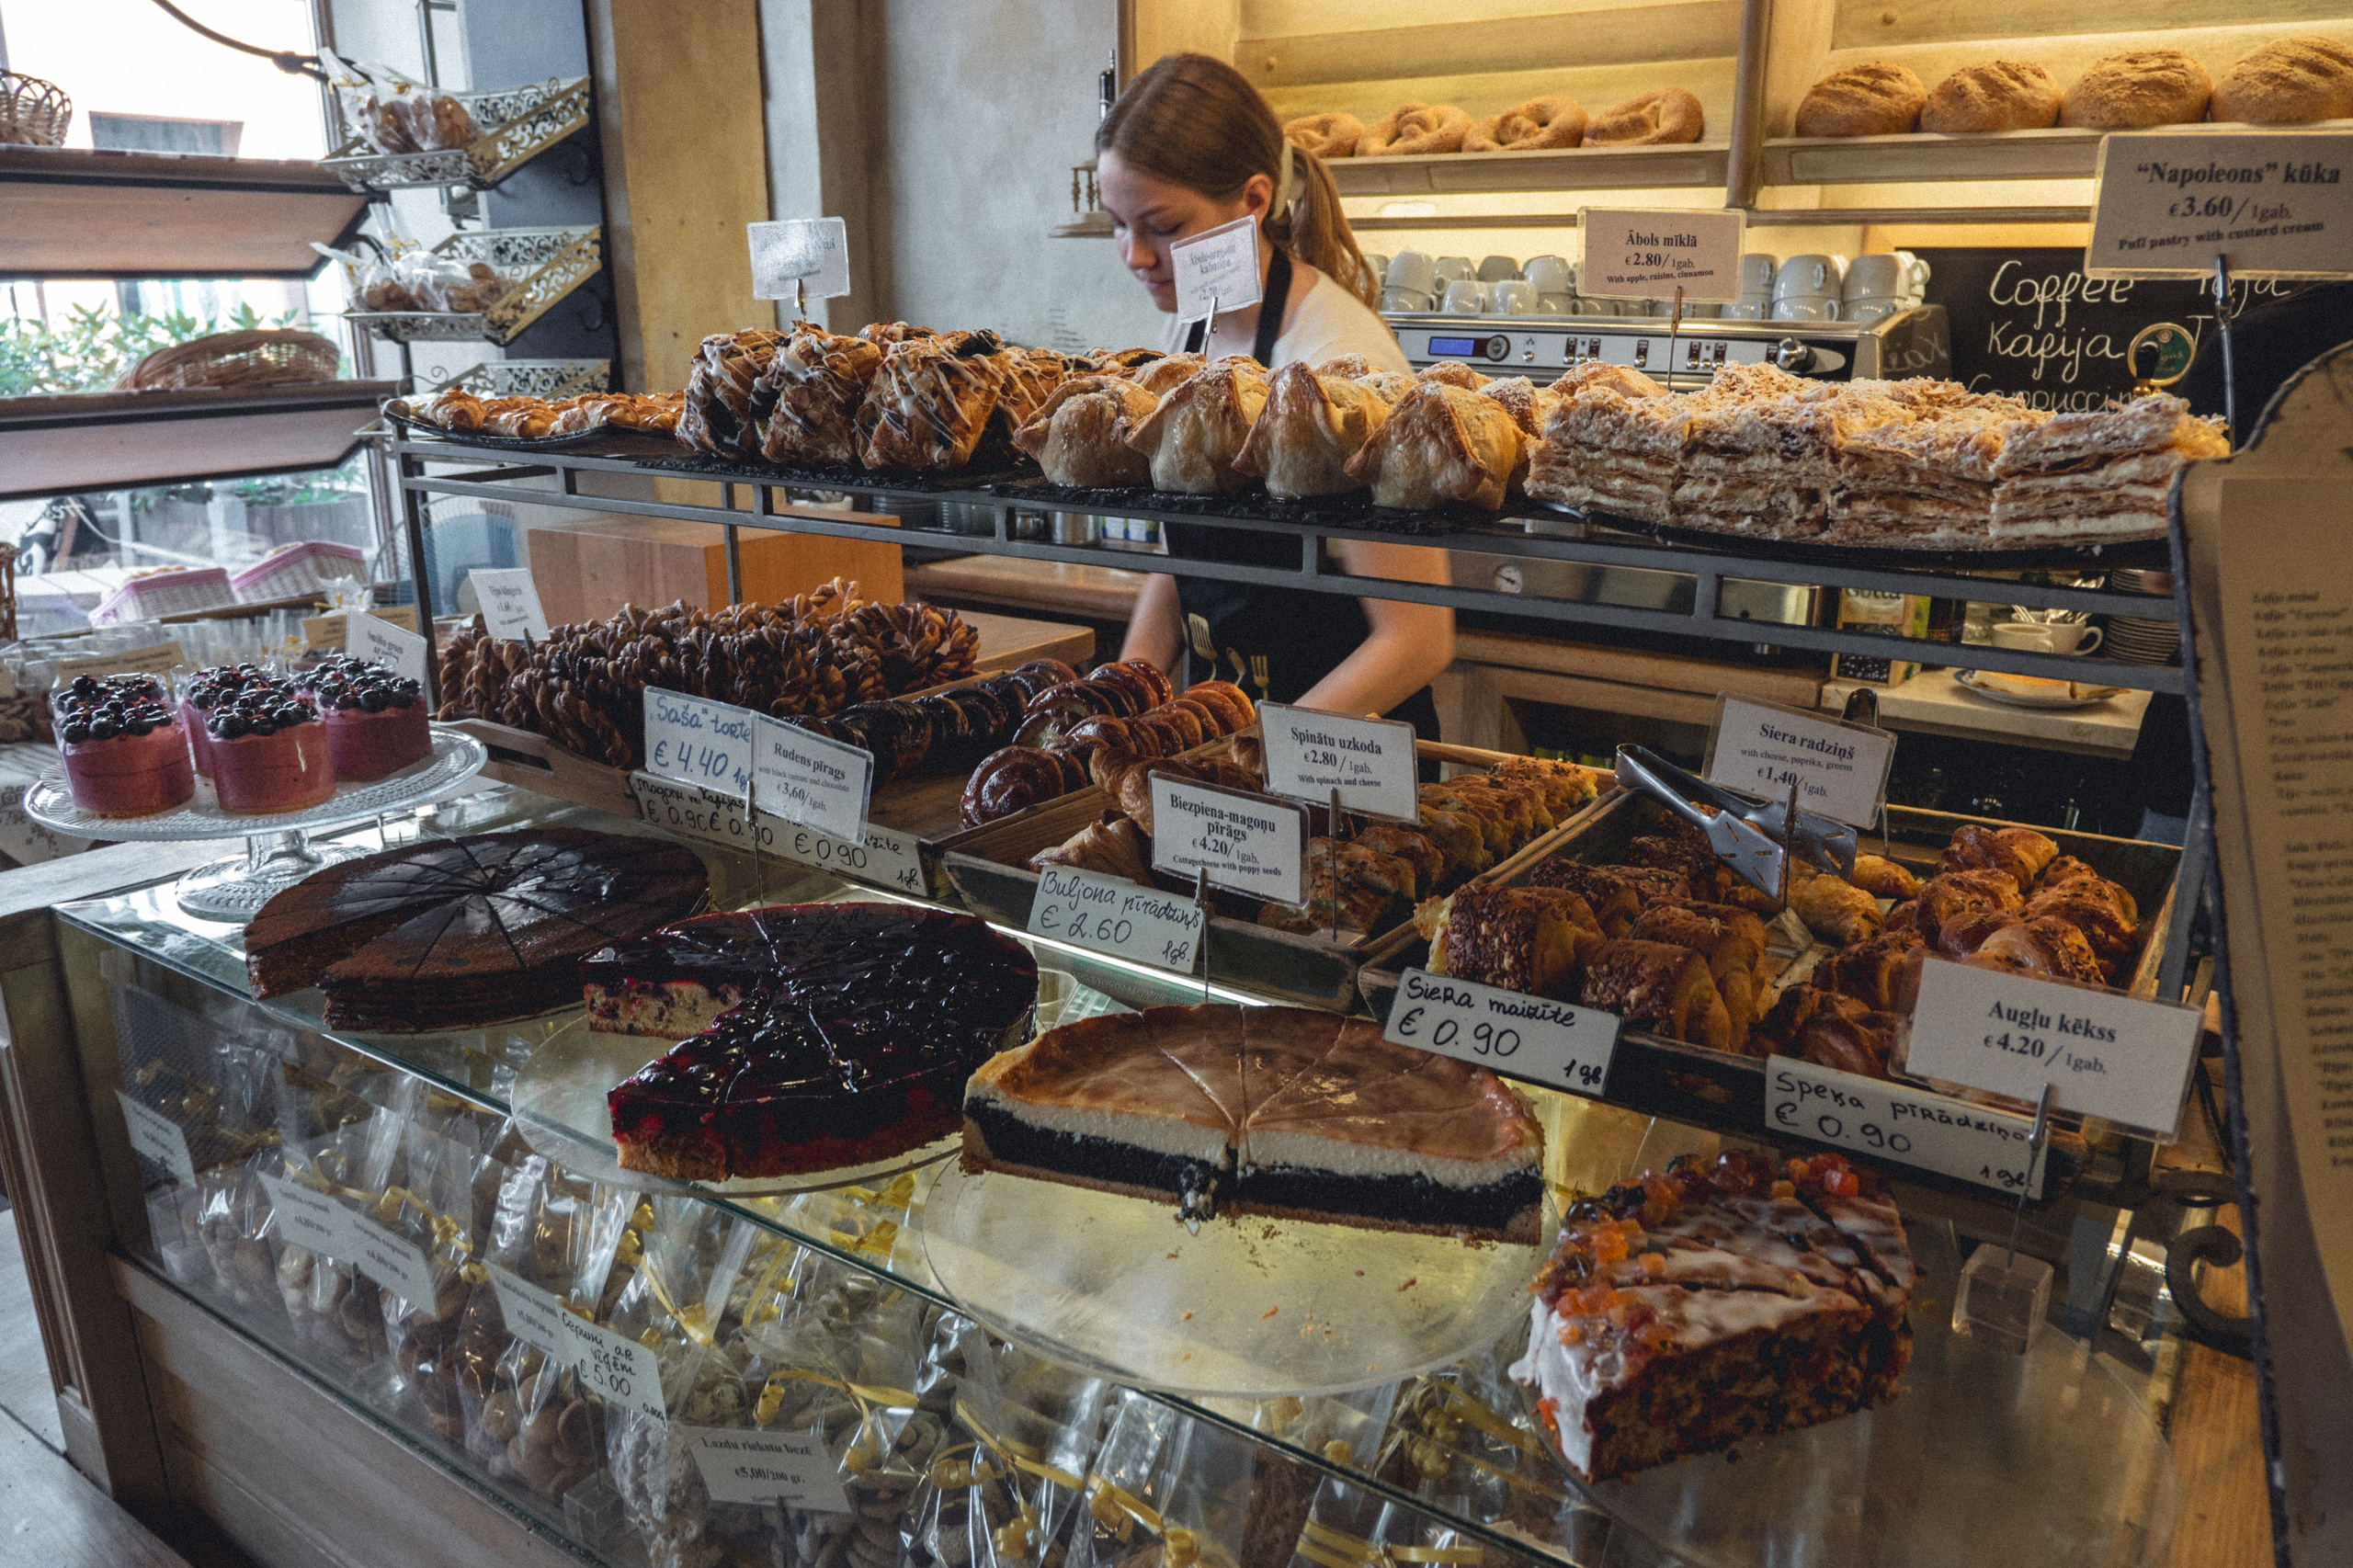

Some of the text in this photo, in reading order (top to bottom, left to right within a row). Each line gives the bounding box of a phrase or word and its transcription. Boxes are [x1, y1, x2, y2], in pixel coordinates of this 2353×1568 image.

[2283, 162, 2340, 184] kūka
[1625, 230, 1698, 247] Ābols mīklā
[2119, 222, 2325, 251] Puff pastry with custard cream
[1626, 275, 1648, 284] apple,
[1650, 273, 1676, 281] raisins,
[1677, 269, 1714, 278] cinnamon
[1990, 260, 2134, 331] Coffee
[1988, 321, 2125, 383] Kafija
[774, 742, 812, 767] Rudens
[1291, 727, 1381, 755] Spinātu uzkoda
[1759, 723, 1856, 762] Siera radziņš
[654, 740, 669, 768] €
[677, 742, 728, 777] 4.40
[1741, 747, 1853, 772] with cheese, paprika, greens
[772, 768, 787, 778] black
[810, 778, 820, 786] and
[821, 780, 850, 792] chocolate
[1298, 775, 1314, 783] With
[1316, 777, 1342, 786] spinach
[1358, 778, 1381, 787] cheese
[1170, 793, 1276, 834] Biezpiena-magoņu
[1207, 822, 1247, 843] pīrāgs
[816, 839, 867, 869] 0.90
[1173, 855, 1281, 876] Cottagecheese with poppy seeds
[1041, 870, 1115, 911] Buljona
[1040, 905, 1132, 944] € 2.60
[1398, 1007, 1520, 1056] € 0.90
[1988, 1001, 2117, 1043] Augļu kēkss
[1775, 1102, 1912, 1153] € 0.90
[563, 1312, 604, 1348] Cepumi
[594, 1363, 631, 1396] 5.00
[701, 1437, 739, 1450] Lazdu
